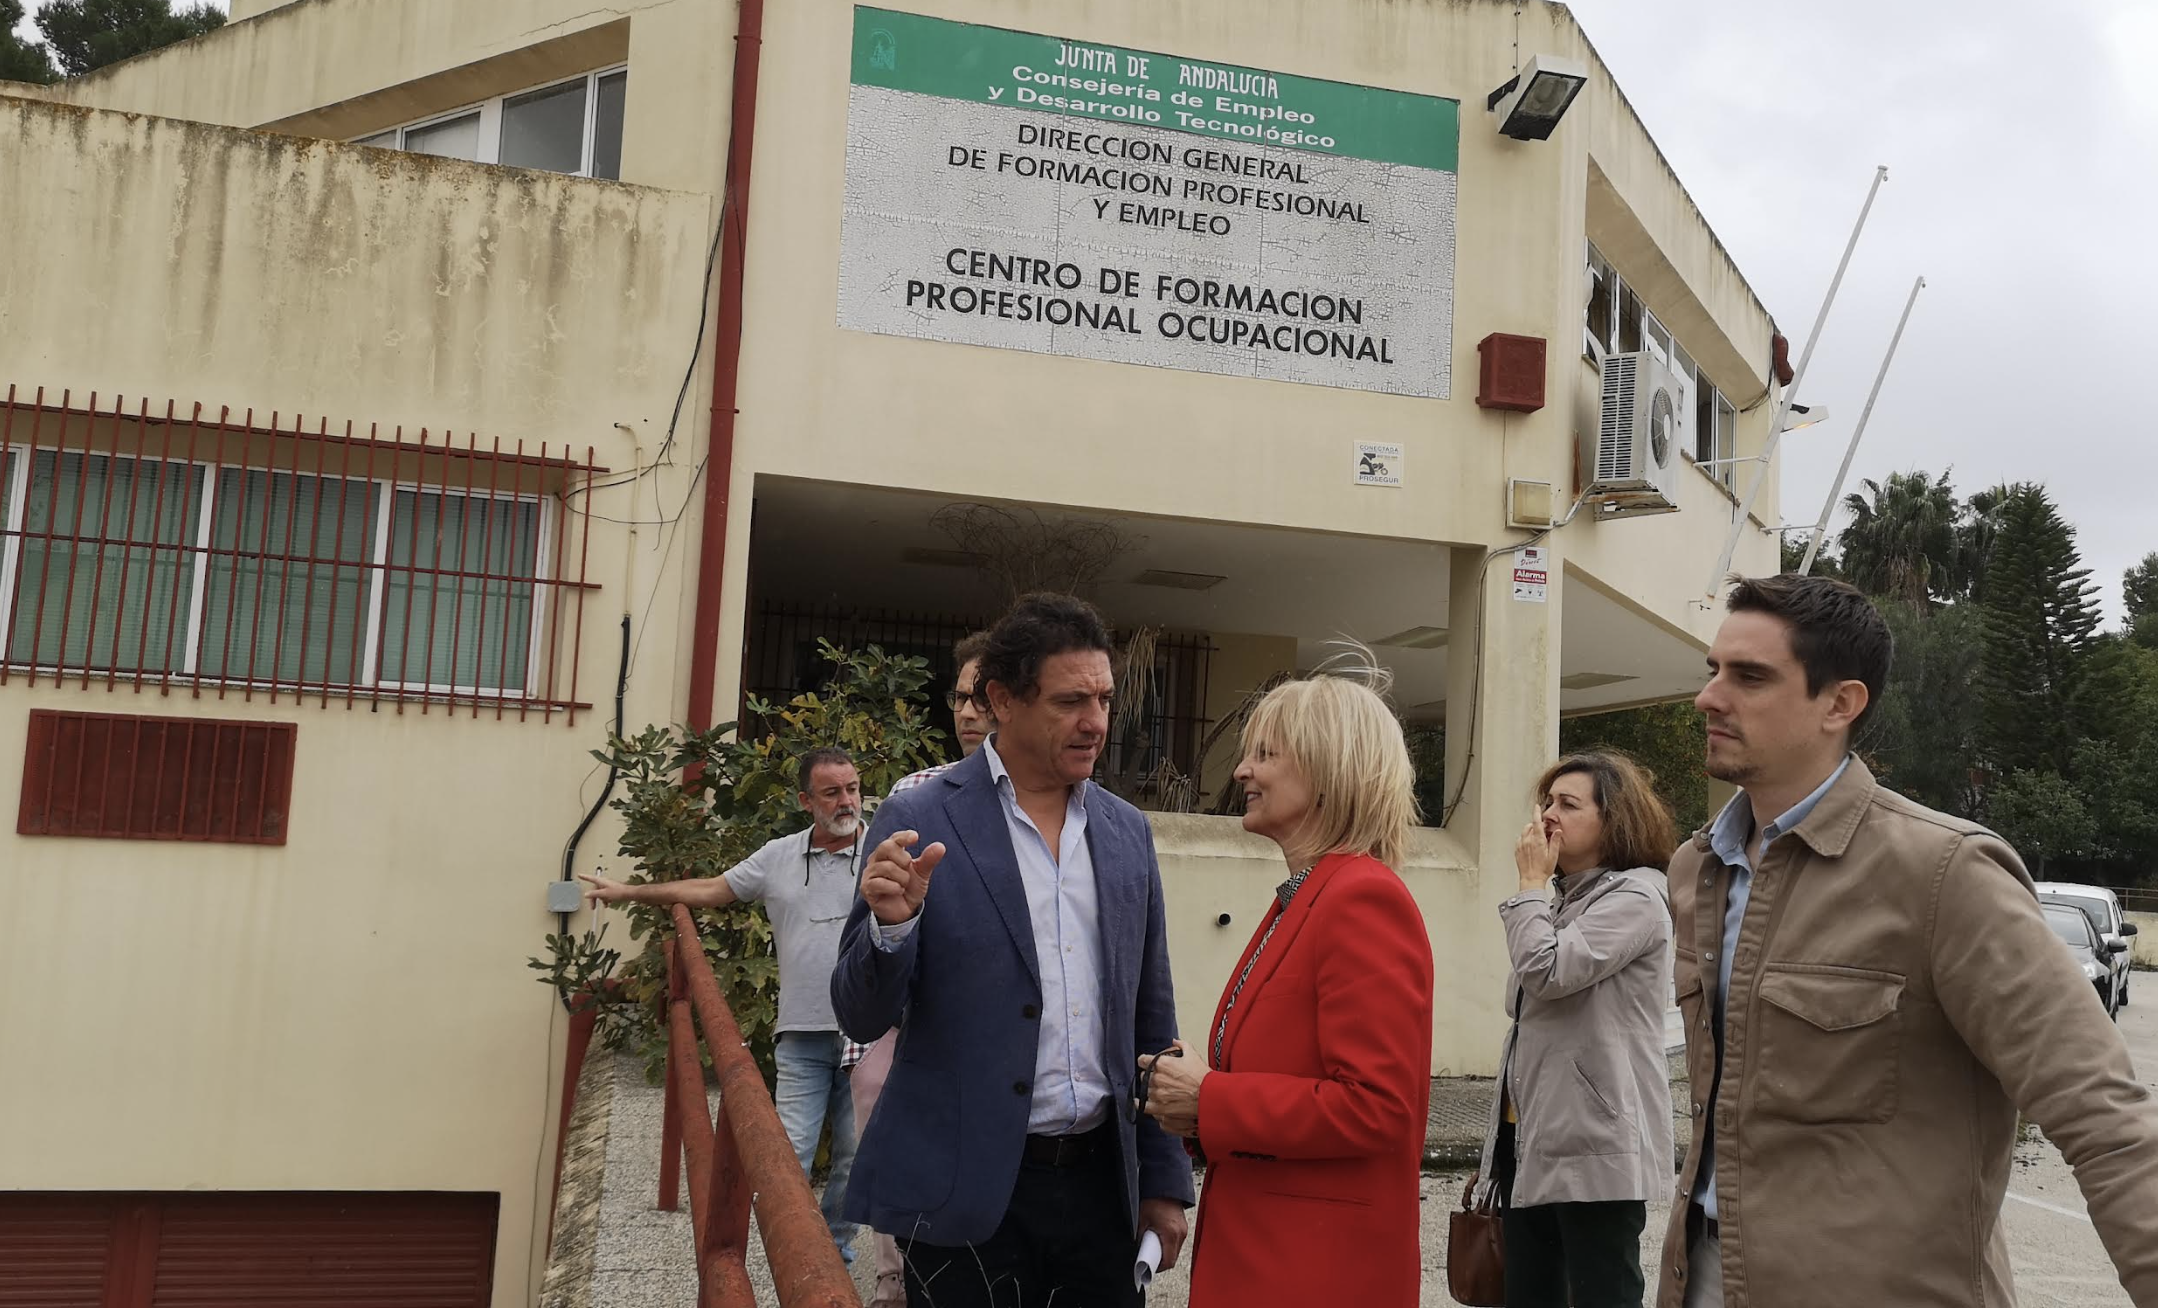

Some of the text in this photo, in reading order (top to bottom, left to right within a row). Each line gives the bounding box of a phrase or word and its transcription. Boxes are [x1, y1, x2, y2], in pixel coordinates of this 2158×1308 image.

[1012, 65, 1315, 124] Consejería de Empleo
[1055, 44, 1279, 99] JUNTA DE ANDALUCIA
[988, 86, 1335, 147] y Desarrollo Tecnológico
[1018, 124, 1309, 184] DIRECCION GENERAL
[948, 146, 1370, 223] DE FORMACION PROFESIONAL
[1093, 199, 1231, 235] Y EMPLEO
[946, 248, 1362, 324] CENTRO DE FORMACION
[906, 280, 1393, 364] PROFESIONAL OCUPACIONAL
[1359, 475, 1399, 484] PROSEGUR
[1516, 570, 1546, 579] Alarma
